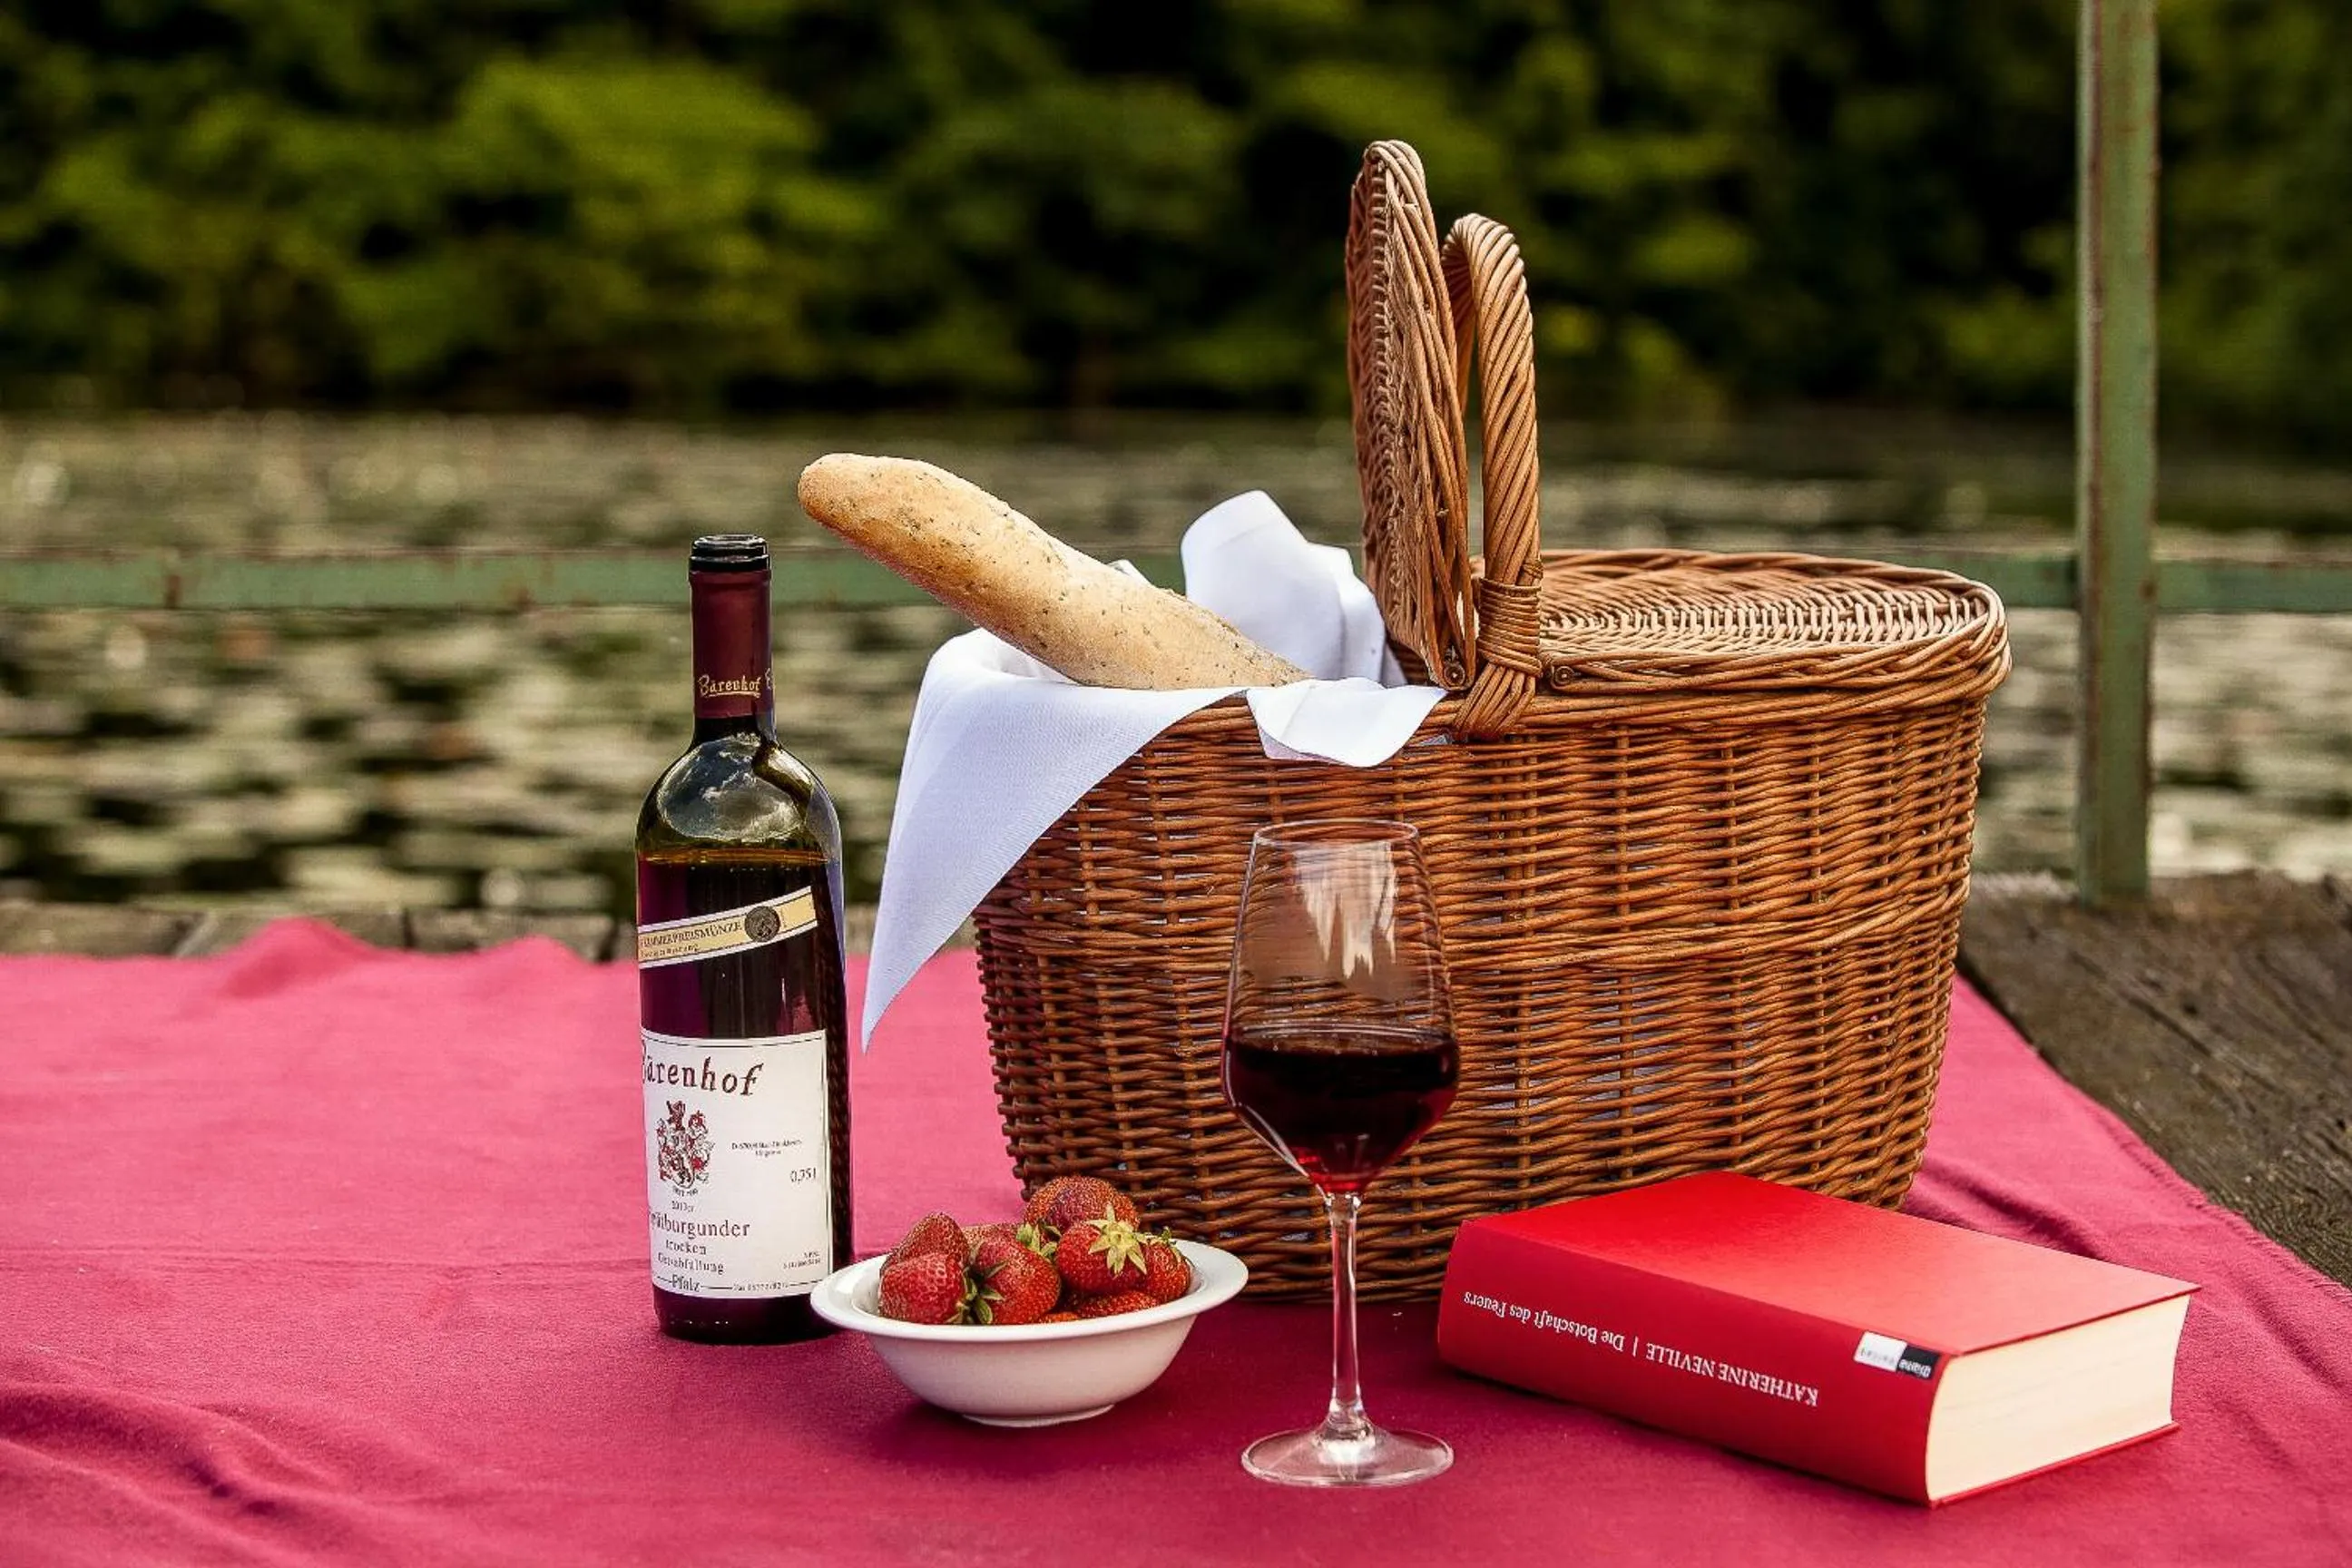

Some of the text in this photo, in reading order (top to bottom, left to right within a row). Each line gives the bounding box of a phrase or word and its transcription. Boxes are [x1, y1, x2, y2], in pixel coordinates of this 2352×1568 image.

[643, 1056, 764, 1096] ärenhof
[665, 1239, 707, 1256] trocken
[671, 1274, 701, 1293] Pfalz
[1463, 1291, 1819, 1407] KATHERINE NEVILLE Die Botschaft des Feuers
